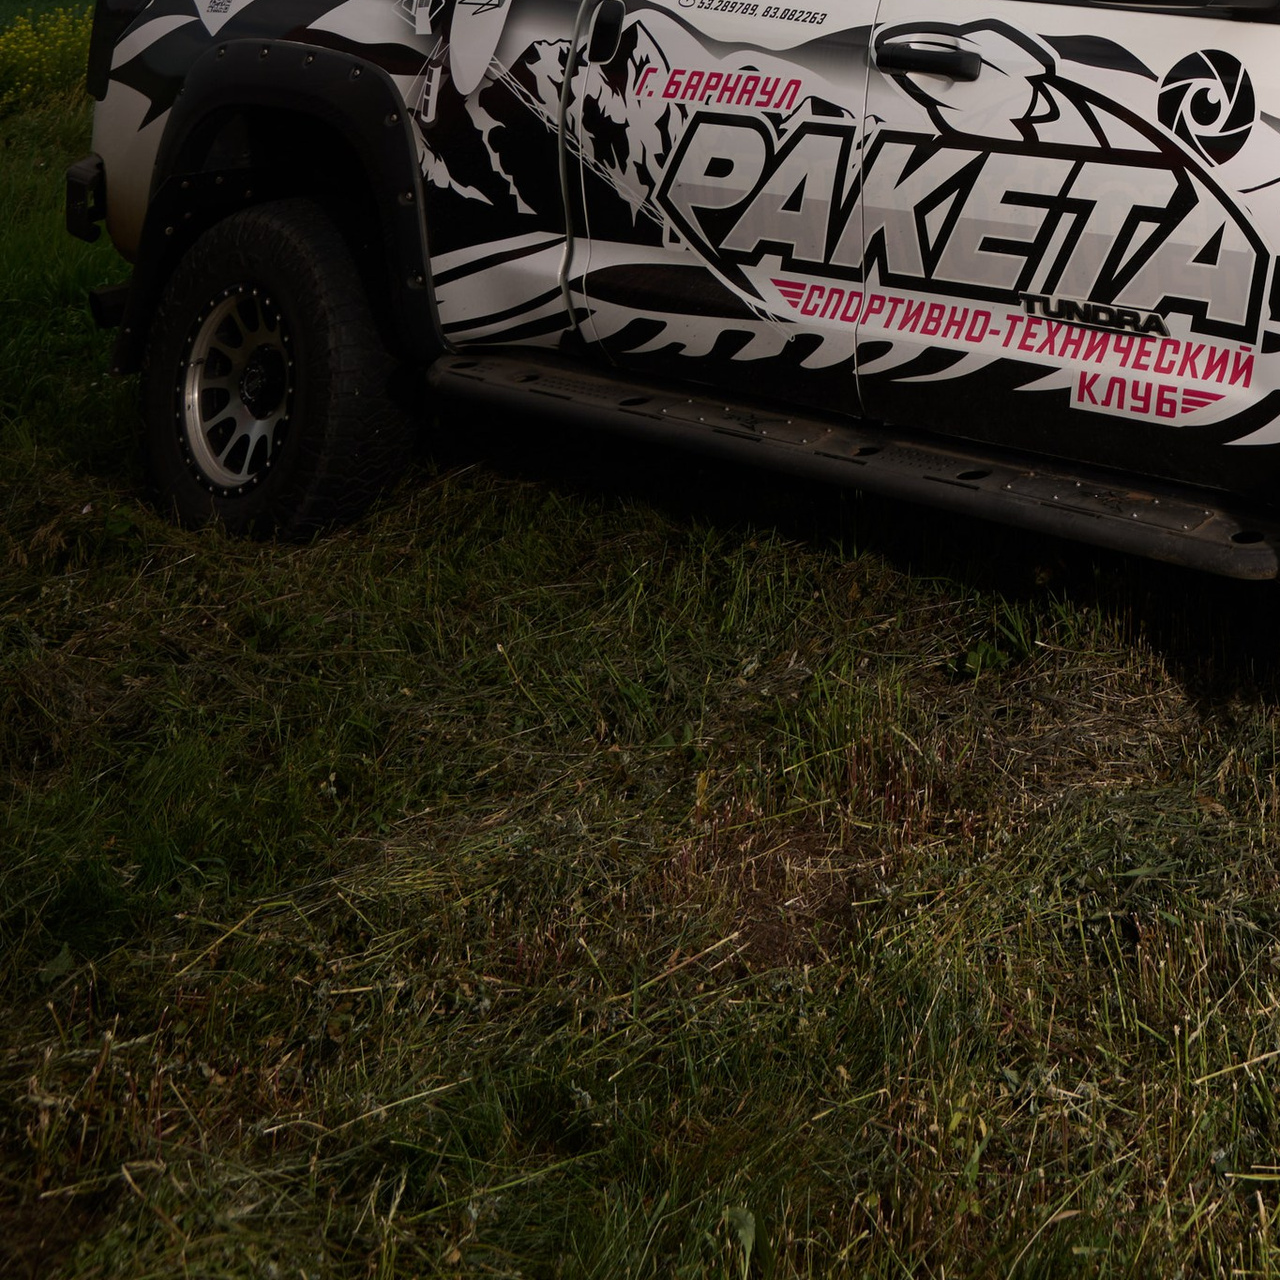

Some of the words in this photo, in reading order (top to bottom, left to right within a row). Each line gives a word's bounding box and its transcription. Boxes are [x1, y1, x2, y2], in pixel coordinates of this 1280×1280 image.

[762, 5, 828, 25] 83.082263
[662, 69, 802, 110] БАРНАУЛ
[664, 122, 1262, 329] РАКЕТА
[800, 284, 1255, 389] СПОРТИВНО-ТЕХНИЧЕСКИЙ
[1019, 292, 1171, 339] TUNDRA
[1077, 371, 1178, 419] КЛУБ
